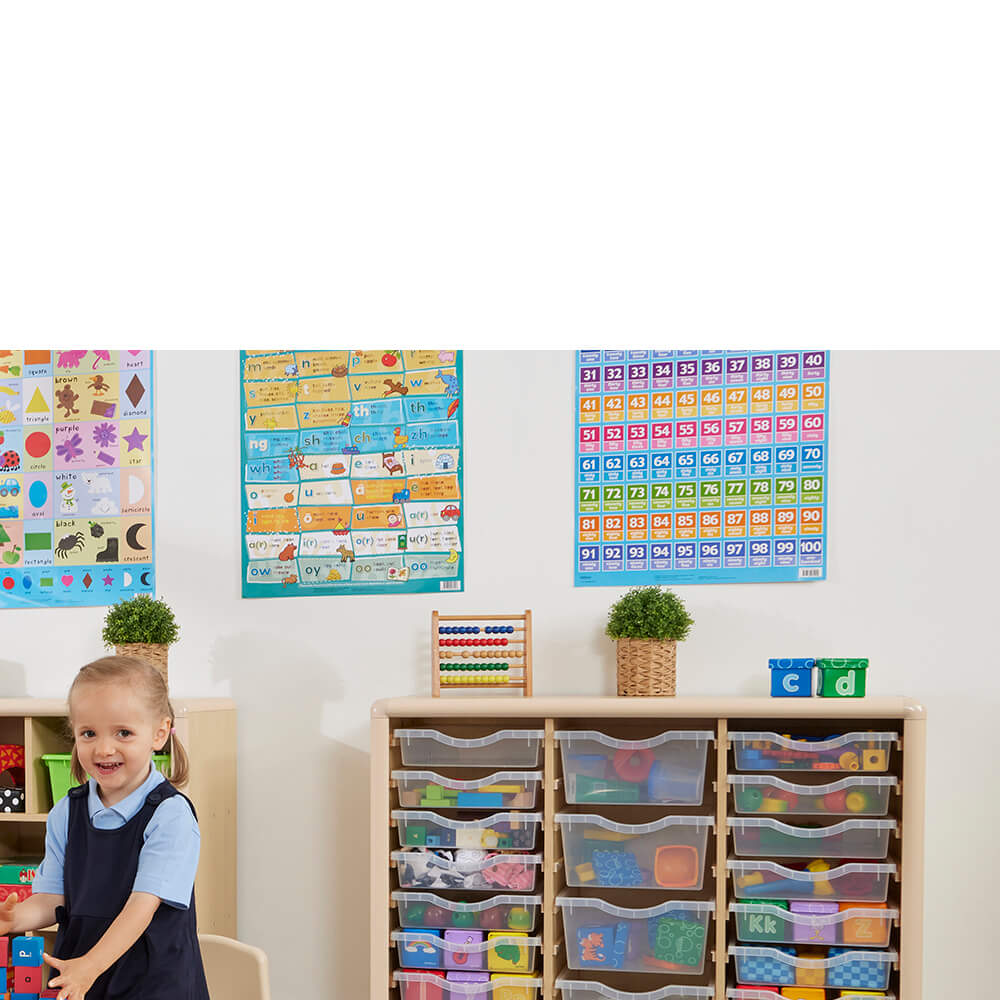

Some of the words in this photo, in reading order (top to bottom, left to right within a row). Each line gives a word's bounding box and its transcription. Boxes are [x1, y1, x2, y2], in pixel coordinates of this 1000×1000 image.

[302, 360, 310, 368] n
[352, 356, 360, 368] p
[248, 363, 262, 372] m
[584, 370, 595, 380] 31
[608, 368, 621, 379] 32
[632, 367, 645, 377] 33
[655, 364, 670, 376] 34
[680, 363, 694, 374] 35
[705, 362, 720, 372] 36
[730, 360, 745, 371] 37
[755, 358, 770, 369] 38
[781, 357, 796, 367] 39
[806, 355, 822, 365] 40
[55, 376, 78, 384] brown
[410, 379, 423, 387] w
[354, 383, 361, 392] v
[249, 390, 256, 399] s
[353, 404, 369, 417] th
[410, 402, 425, 413] th
[249, 415, 257, 425] y
[55, 425, 79, 434] purple
[411, 428, 427, 440] zh
[304, 434, 320, 447] sh
[354, 431, 370, 444] ch
[249, 439, 268, 452] ng
[250, 462, 270, 473] wh
[309, 463, 317, 471] a
[354, 460, 362, 469] e
[55, 473, 77, 481] white
[250, 491, 258, 500] o
[305, 489, 313, 497] u
[409, 510, 429, 521] a(r)
[55, 520, 76, 528] black
[356, 536, 374, 546] o(r)
[409, 534, 429, 545] u(r)
[249, 541, 267, 551] a(r)
[582, 549, 595, 560] 91
[606, 548, 620, 558] 92
[630, 547, 644, 557] 93
[653, 547, 669, 557] 94
[678, 546, 693, 556] 95
[702, 545, 718, 555] 96
[727, 544, 743, 554] 97
[752, 543, 768, 554] 98
[777, 542, 793, 553] 99
[800, 541, 822, 554] 100
[251, 567, 271, 576] ow
[305, 566, 321, 576] oy
[355, 564, 372, 573] oo
[411, 562, 428, 571] oo
[782, 673, 799, 692] c
[835, 669, 855, 696] d
[749, 914, 776, 934] Kk
